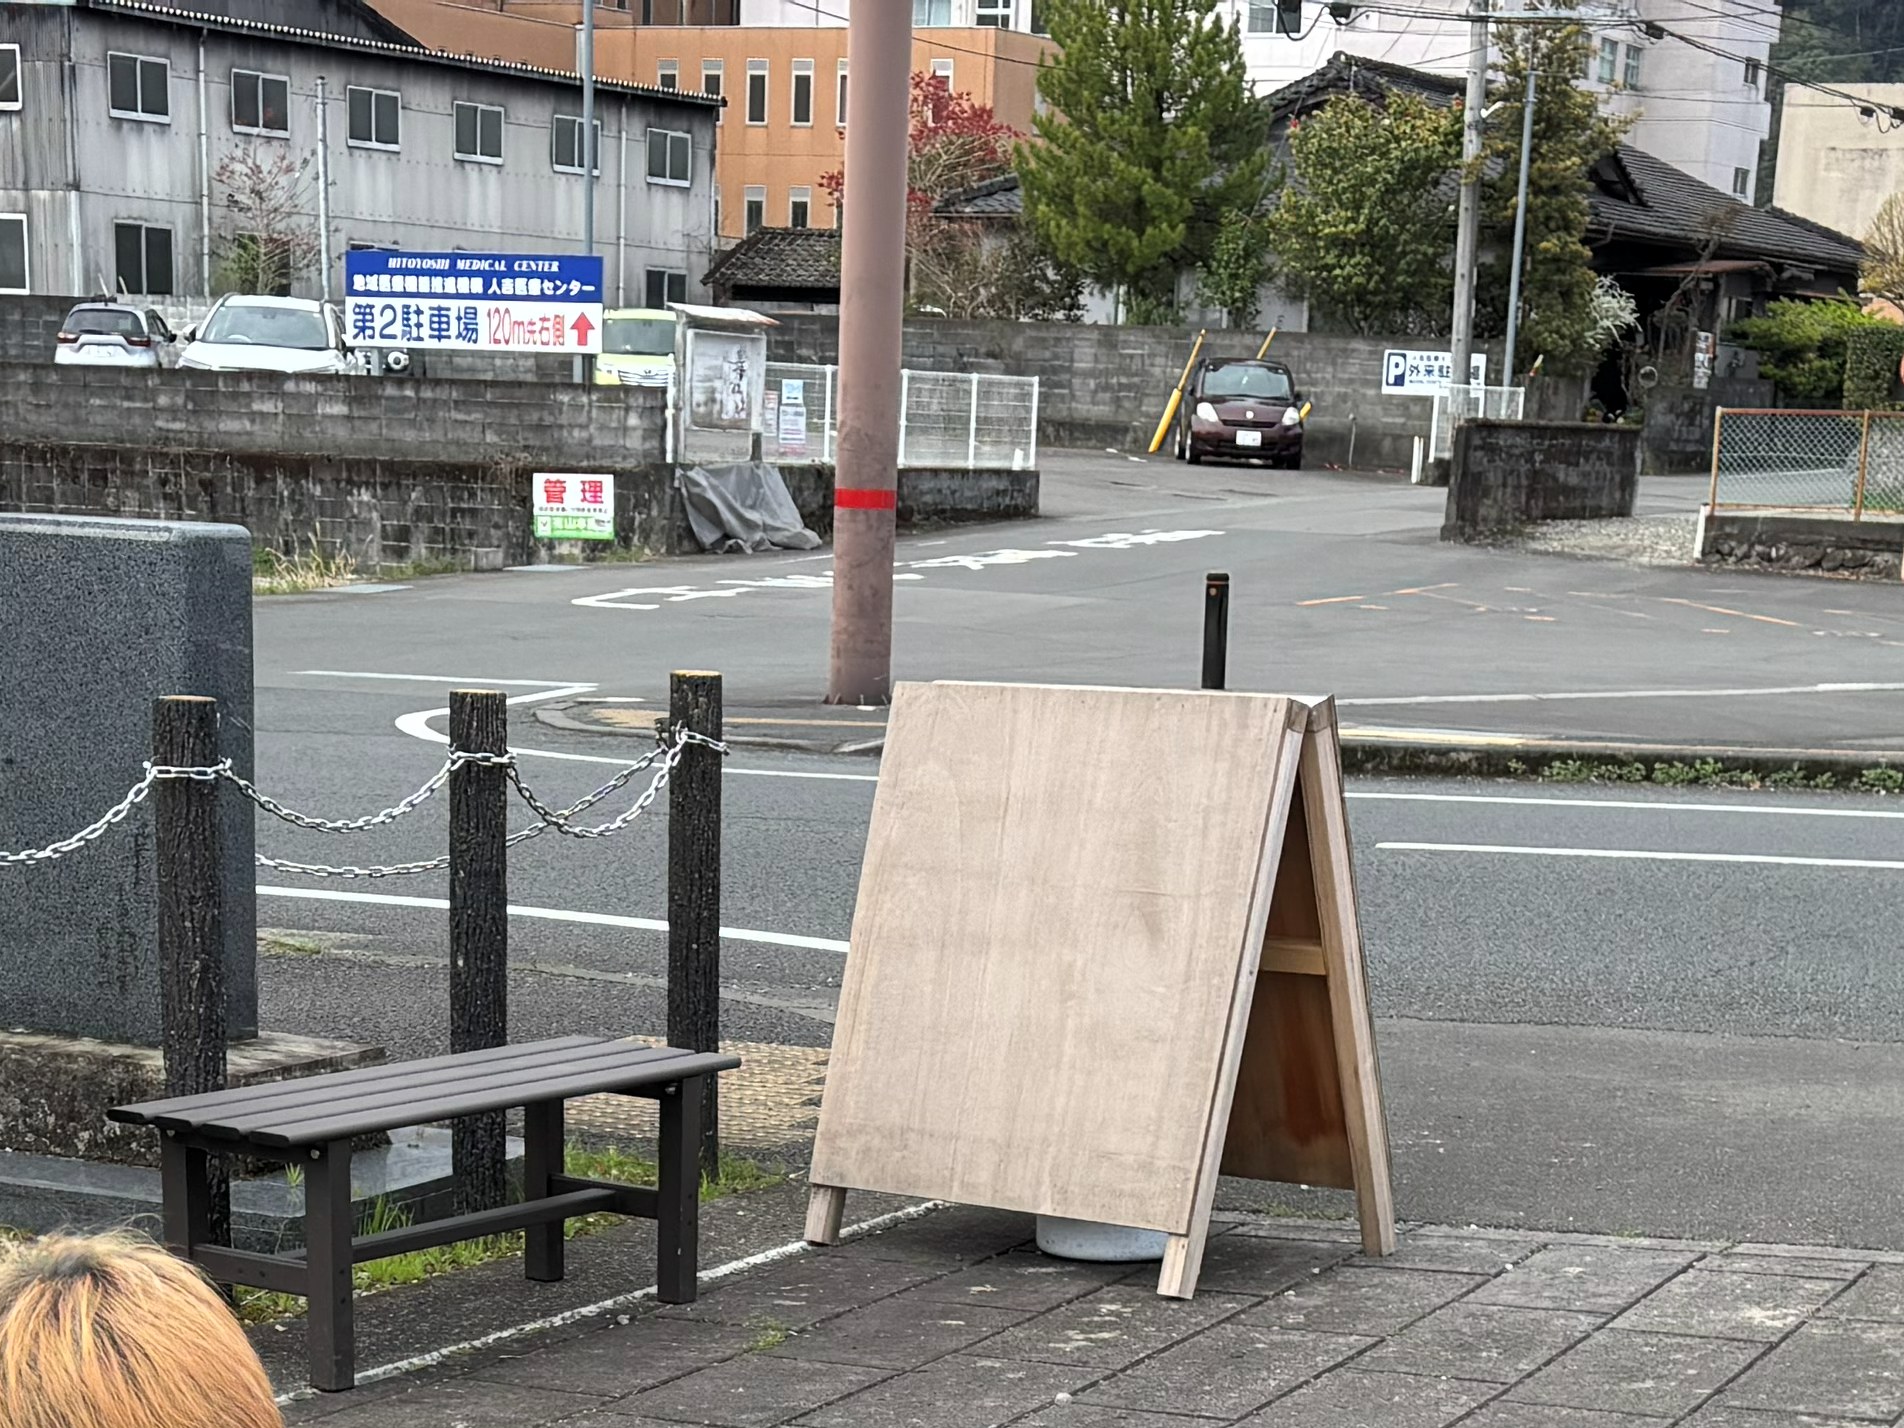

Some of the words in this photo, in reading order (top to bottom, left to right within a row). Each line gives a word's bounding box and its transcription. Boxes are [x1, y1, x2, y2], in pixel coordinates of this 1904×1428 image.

[388, 257, 449, 270] HITOYOSHI
[456, 259, 507, 272] MEDICAL
[514, 261, 560, 272] CENTER
[487, 277, 596, 296] 人吉医療センター
[352, 302, 479, 345] 第2駐車場
[487, 306, 565, 347] 120m先右側
[1387, 354, 1405, 385] P
[1408, 364, 1481, 381] 外来駐場
[543, 478, 604, 504] 管理
